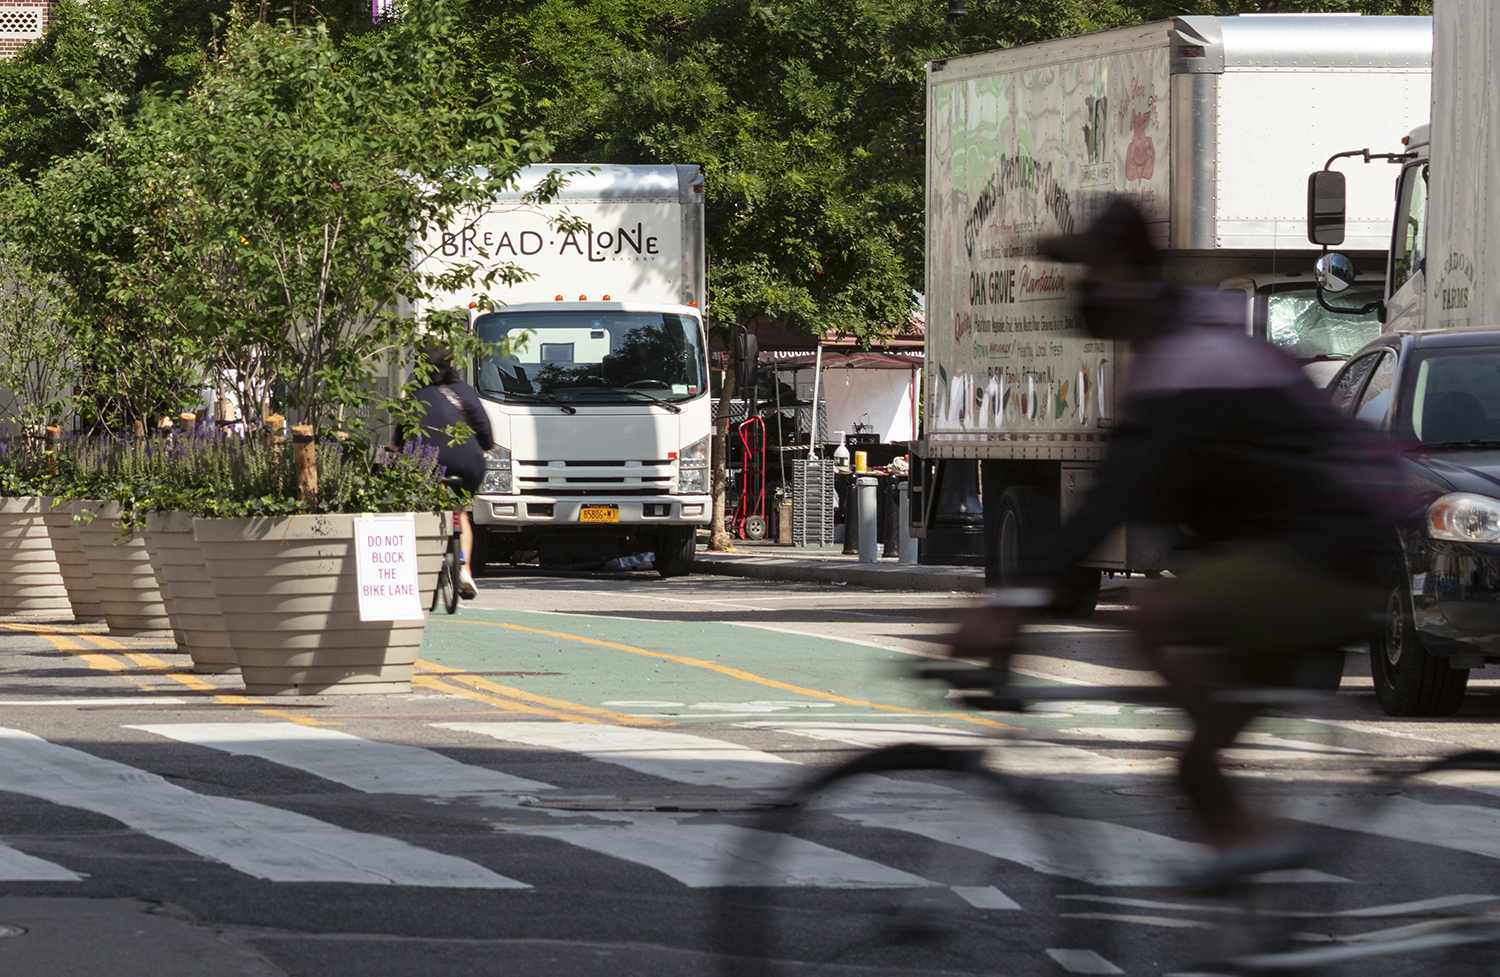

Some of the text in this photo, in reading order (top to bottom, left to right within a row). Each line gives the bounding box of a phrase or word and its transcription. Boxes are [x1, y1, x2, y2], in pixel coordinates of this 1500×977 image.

[442, 222, 659, 262] BREAD ALONE
[969, 264, 1066, 306] OAK GROVE Plantation
[1442, 288, 1468, 310] FARMS
[368, 535, 404, 547] DO NOT
[372, 552, 404, 563] BLOCK
[378, 568, 397, 579] THE
[363, 584, 414, 596] BIKE LANE
